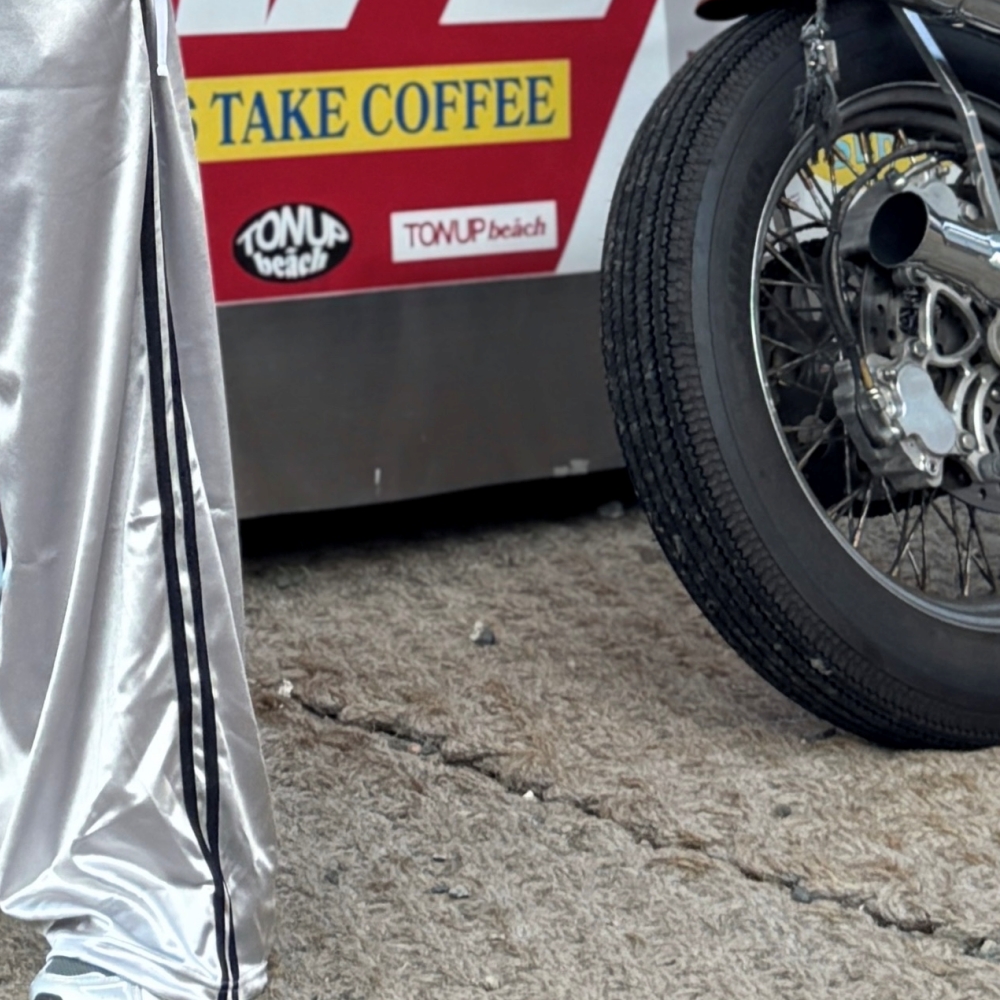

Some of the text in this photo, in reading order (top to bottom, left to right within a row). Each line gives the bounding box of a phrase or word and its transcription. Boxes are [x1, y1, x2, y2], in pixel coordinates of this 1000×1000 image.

[211, 86, 350, 146] TAKE
[361, 75, 557, 137] COFFEE
[235, 204, 350, 257] TONUP
[404, 218, 486, 248] TONUP
